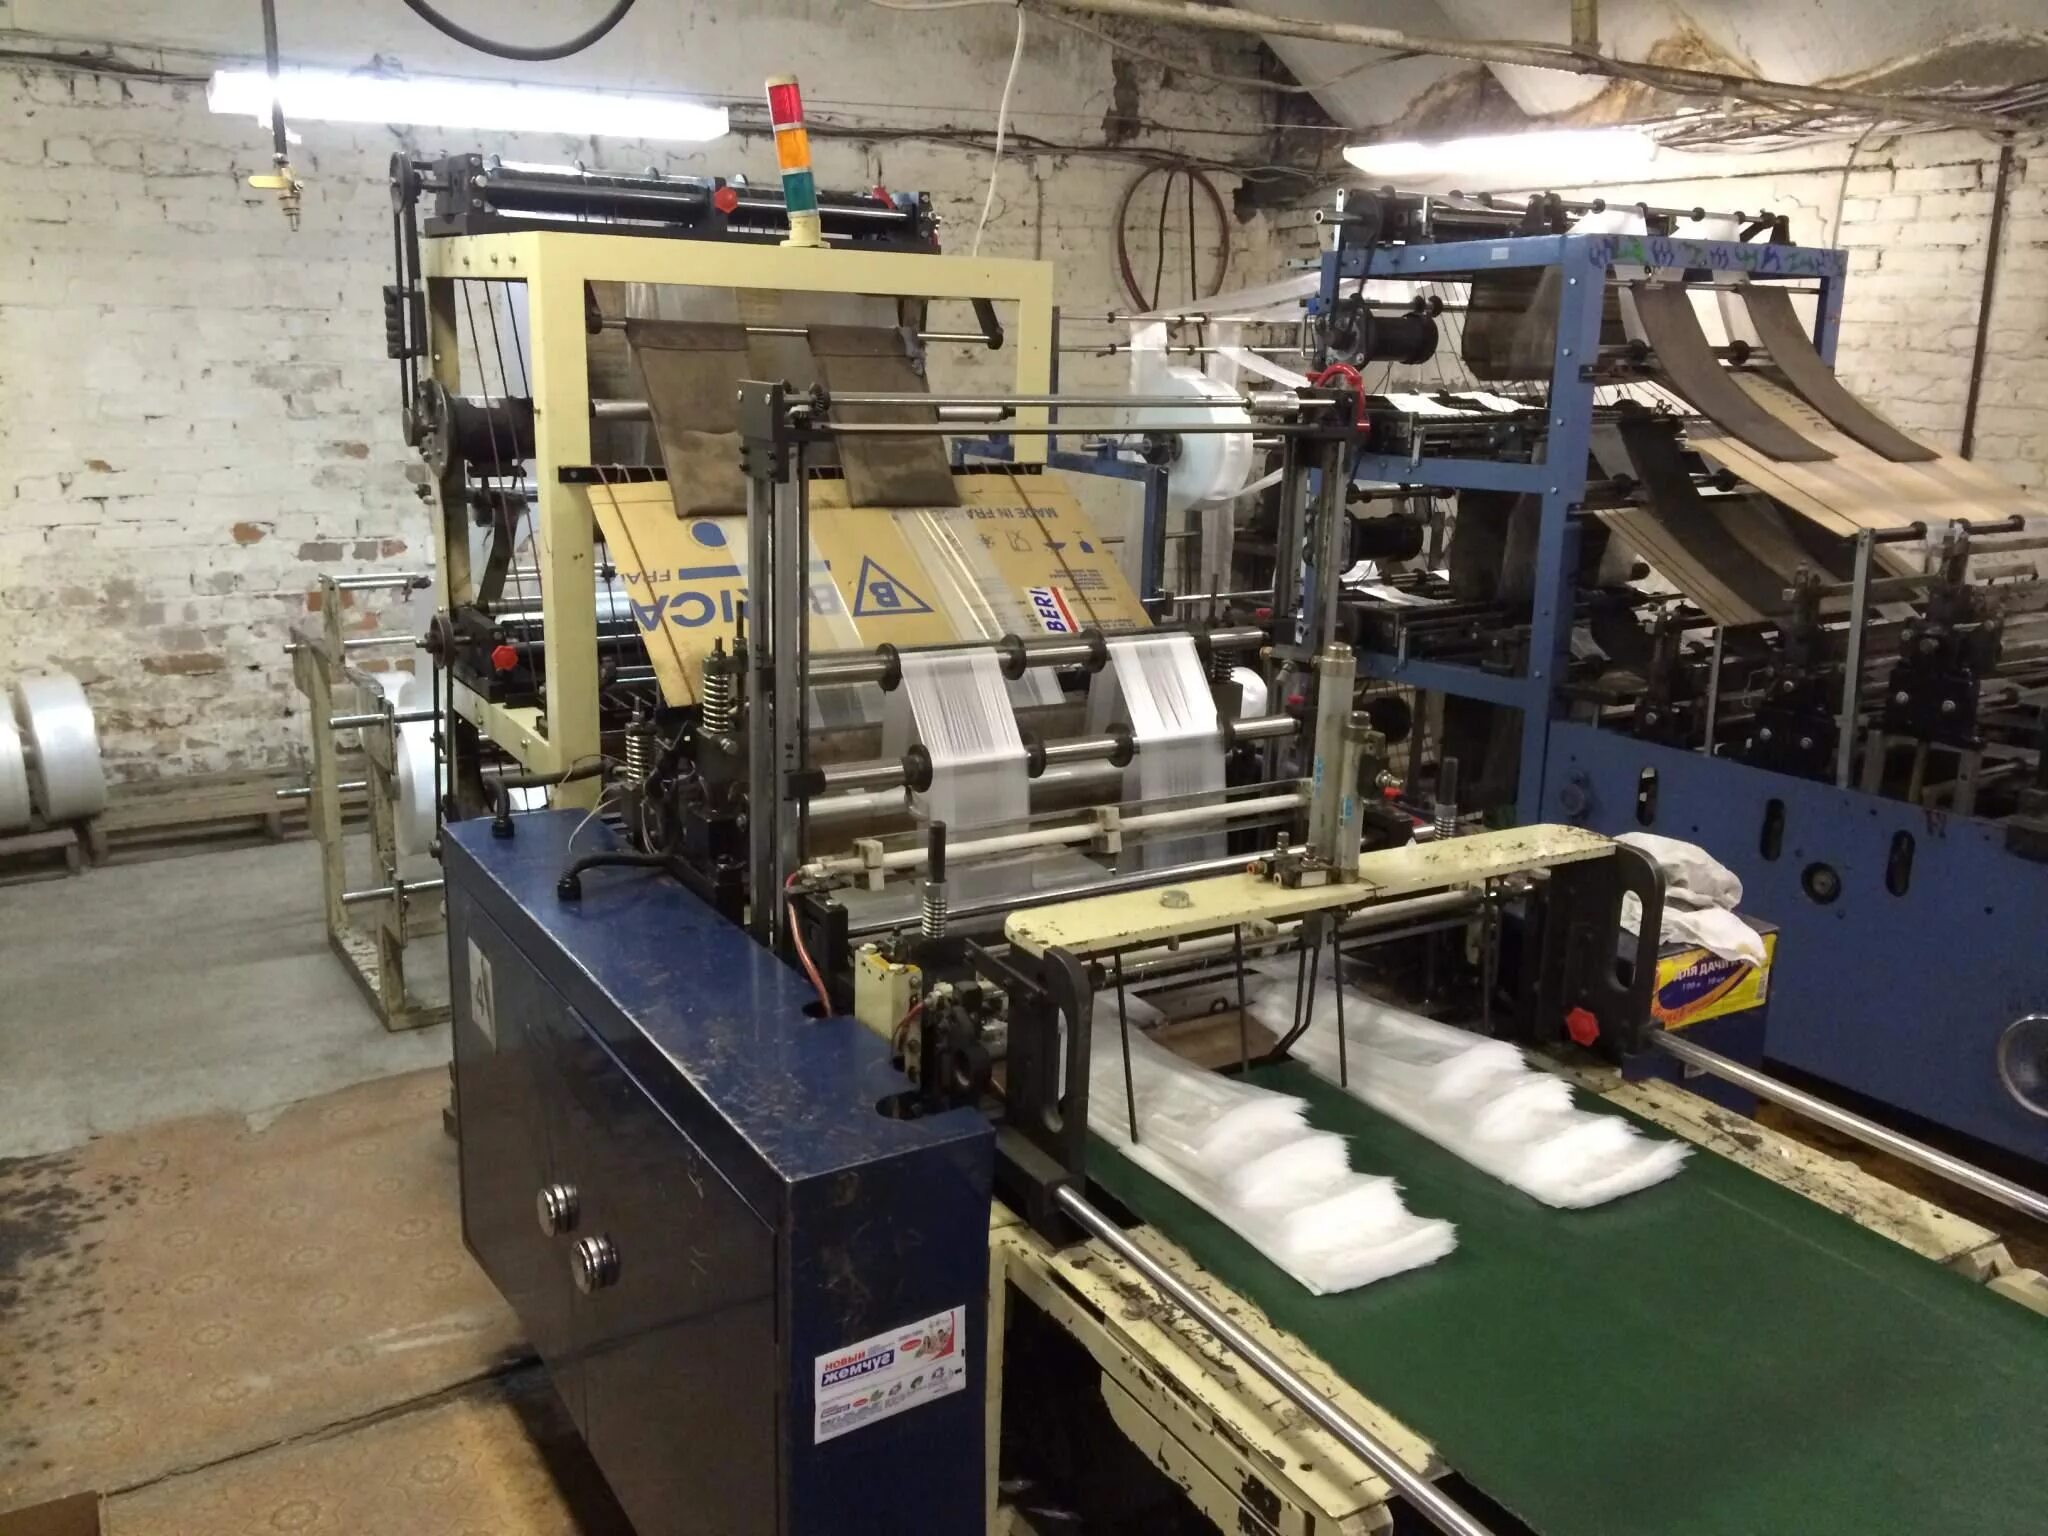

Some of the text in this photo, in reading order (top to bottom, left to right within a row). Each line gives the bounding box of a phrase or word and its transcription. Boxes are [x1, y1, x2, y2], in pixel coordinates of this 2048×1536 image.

[996, 506, 1014, 519] IN
[1015, 505, 1059, 519] MADE
[868, 581, 902, 608] B
[1029, 586, 1067, 632] BERI
